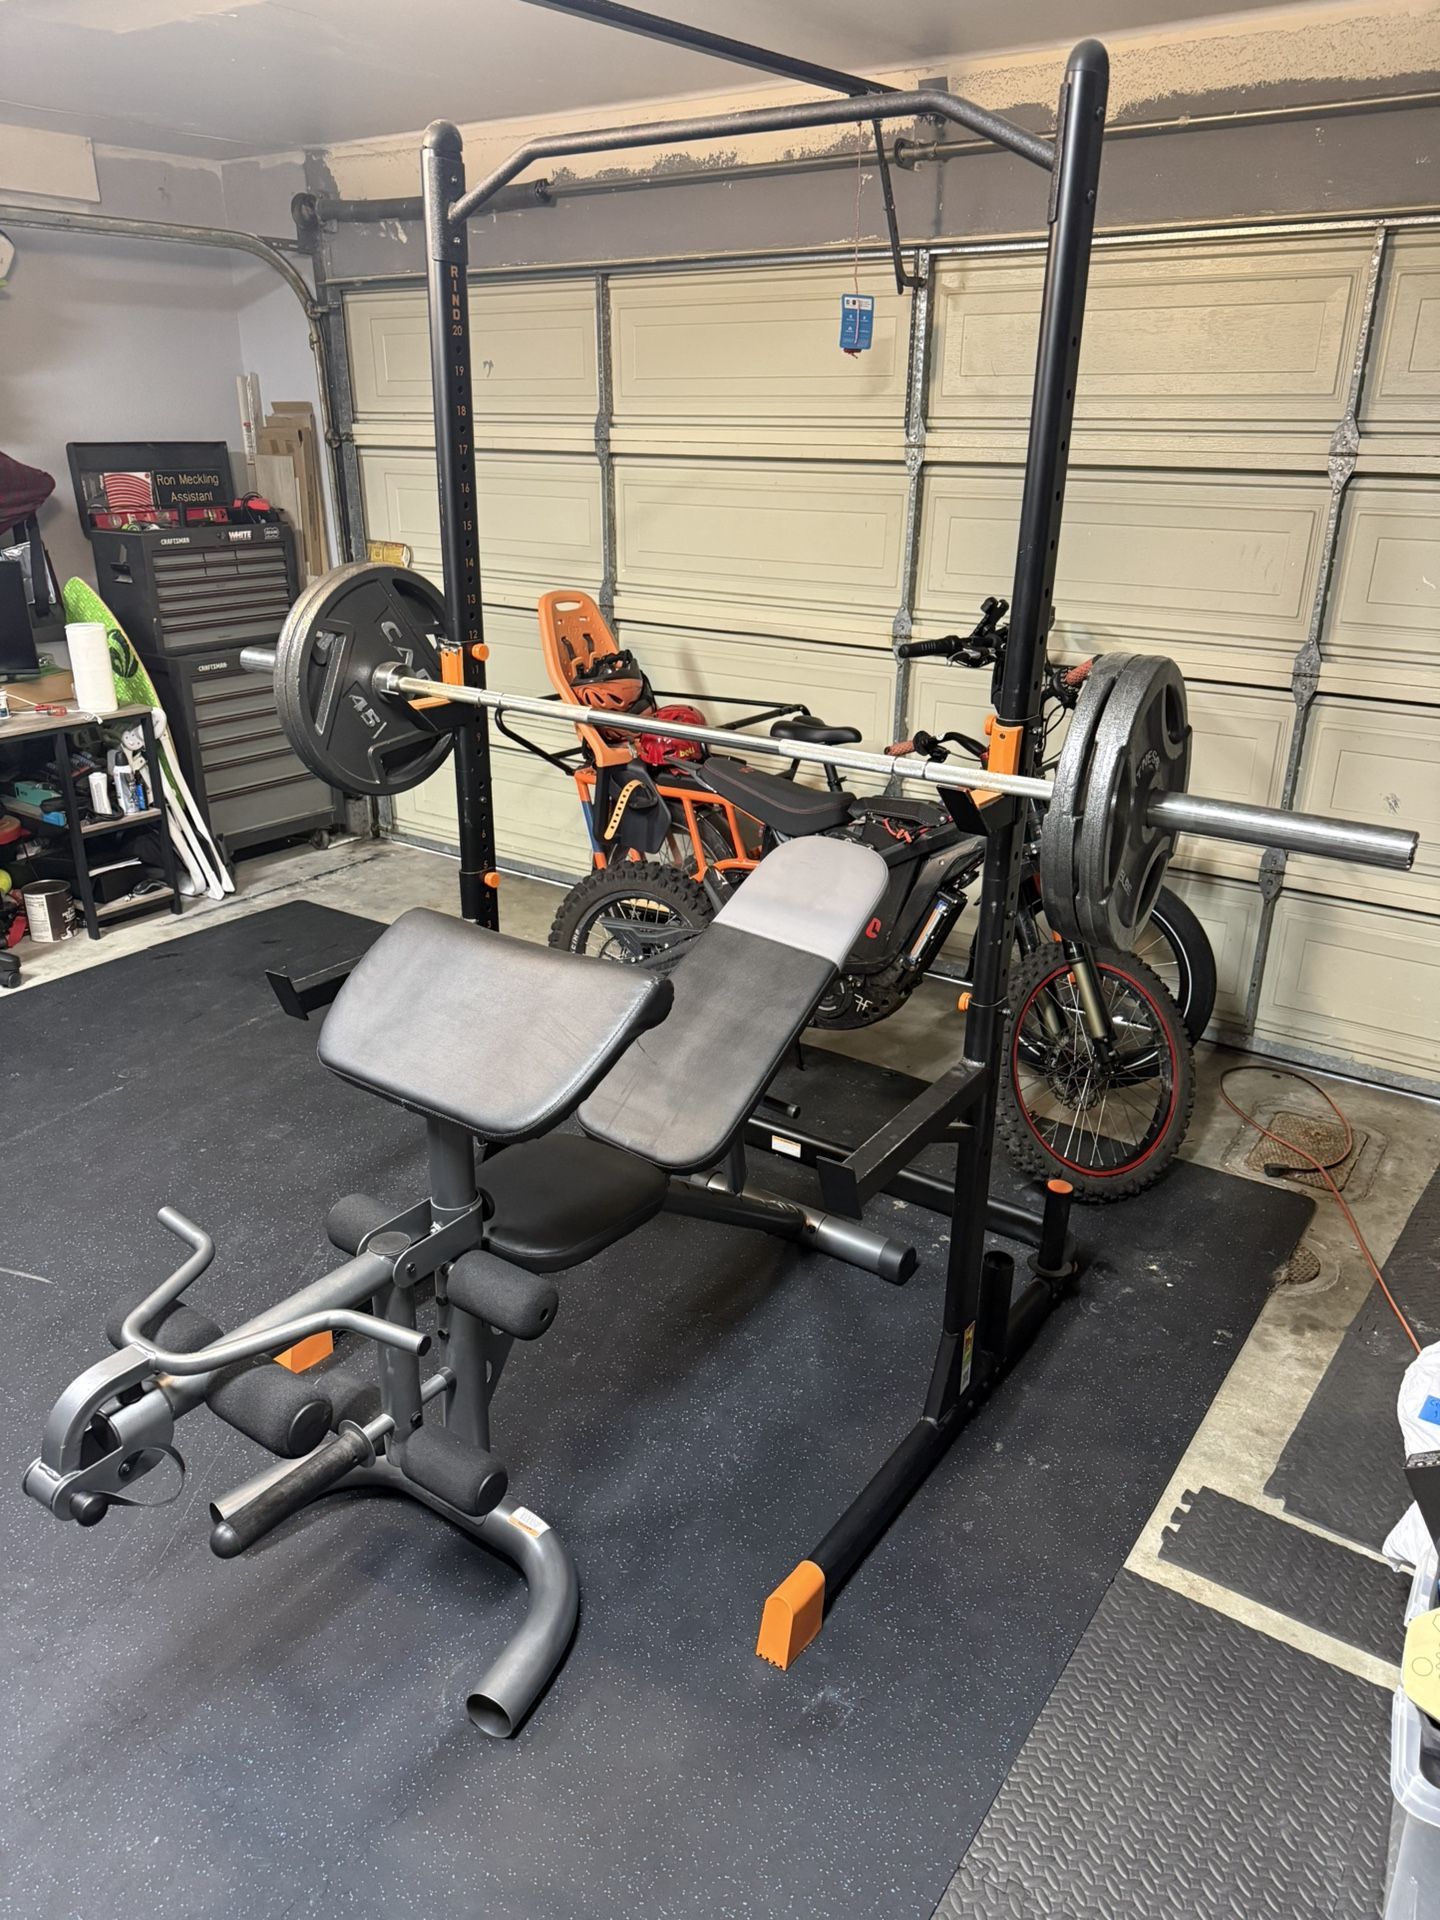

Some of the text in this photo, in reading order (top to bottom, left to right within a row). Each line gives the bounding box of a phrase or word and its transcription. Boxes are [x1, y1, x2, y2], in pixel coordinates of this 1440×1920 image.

[452, 325, 463, 336] 20
[455, 366, 464, 376] 19
[457, 405, 466, 416] 18
[459, 445, 468, 455] 17
[156, 474, 219, 486] Ron Meckling
[461, 482, 470, 493] 16
[171, 491, 213, 502] Assistant
[462, 520, 472, 531] 15
[228, 530, 252, 540] WHITE
[160, 537, 190, 546] CRAFTSMAN
[465, 557, 474, 568] 14
[466, 594, 476, 605] 13
[469, 629, 478, 640] 12
[349, 695, 380, 727] 45
